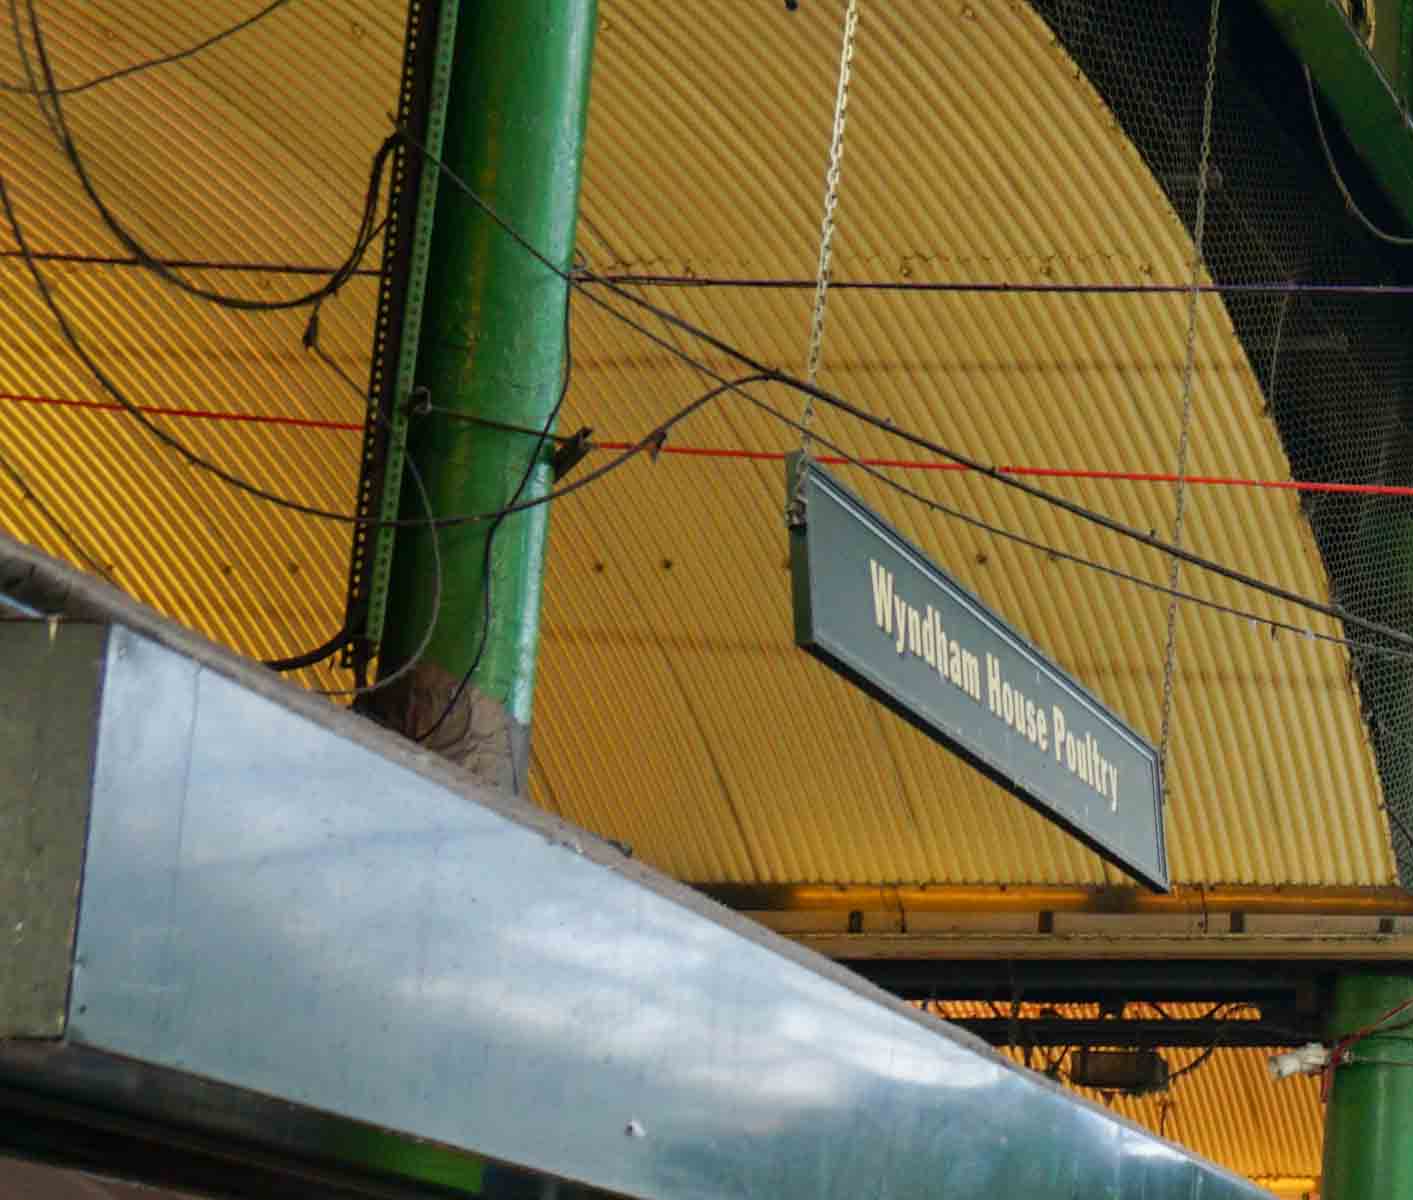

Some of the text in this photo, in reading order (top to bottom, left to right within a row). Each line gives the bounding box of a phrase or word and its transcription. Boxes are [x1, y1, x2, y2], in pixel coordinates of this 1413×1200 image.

[870, 559, 1119, 812] Wyndham House Poultry
